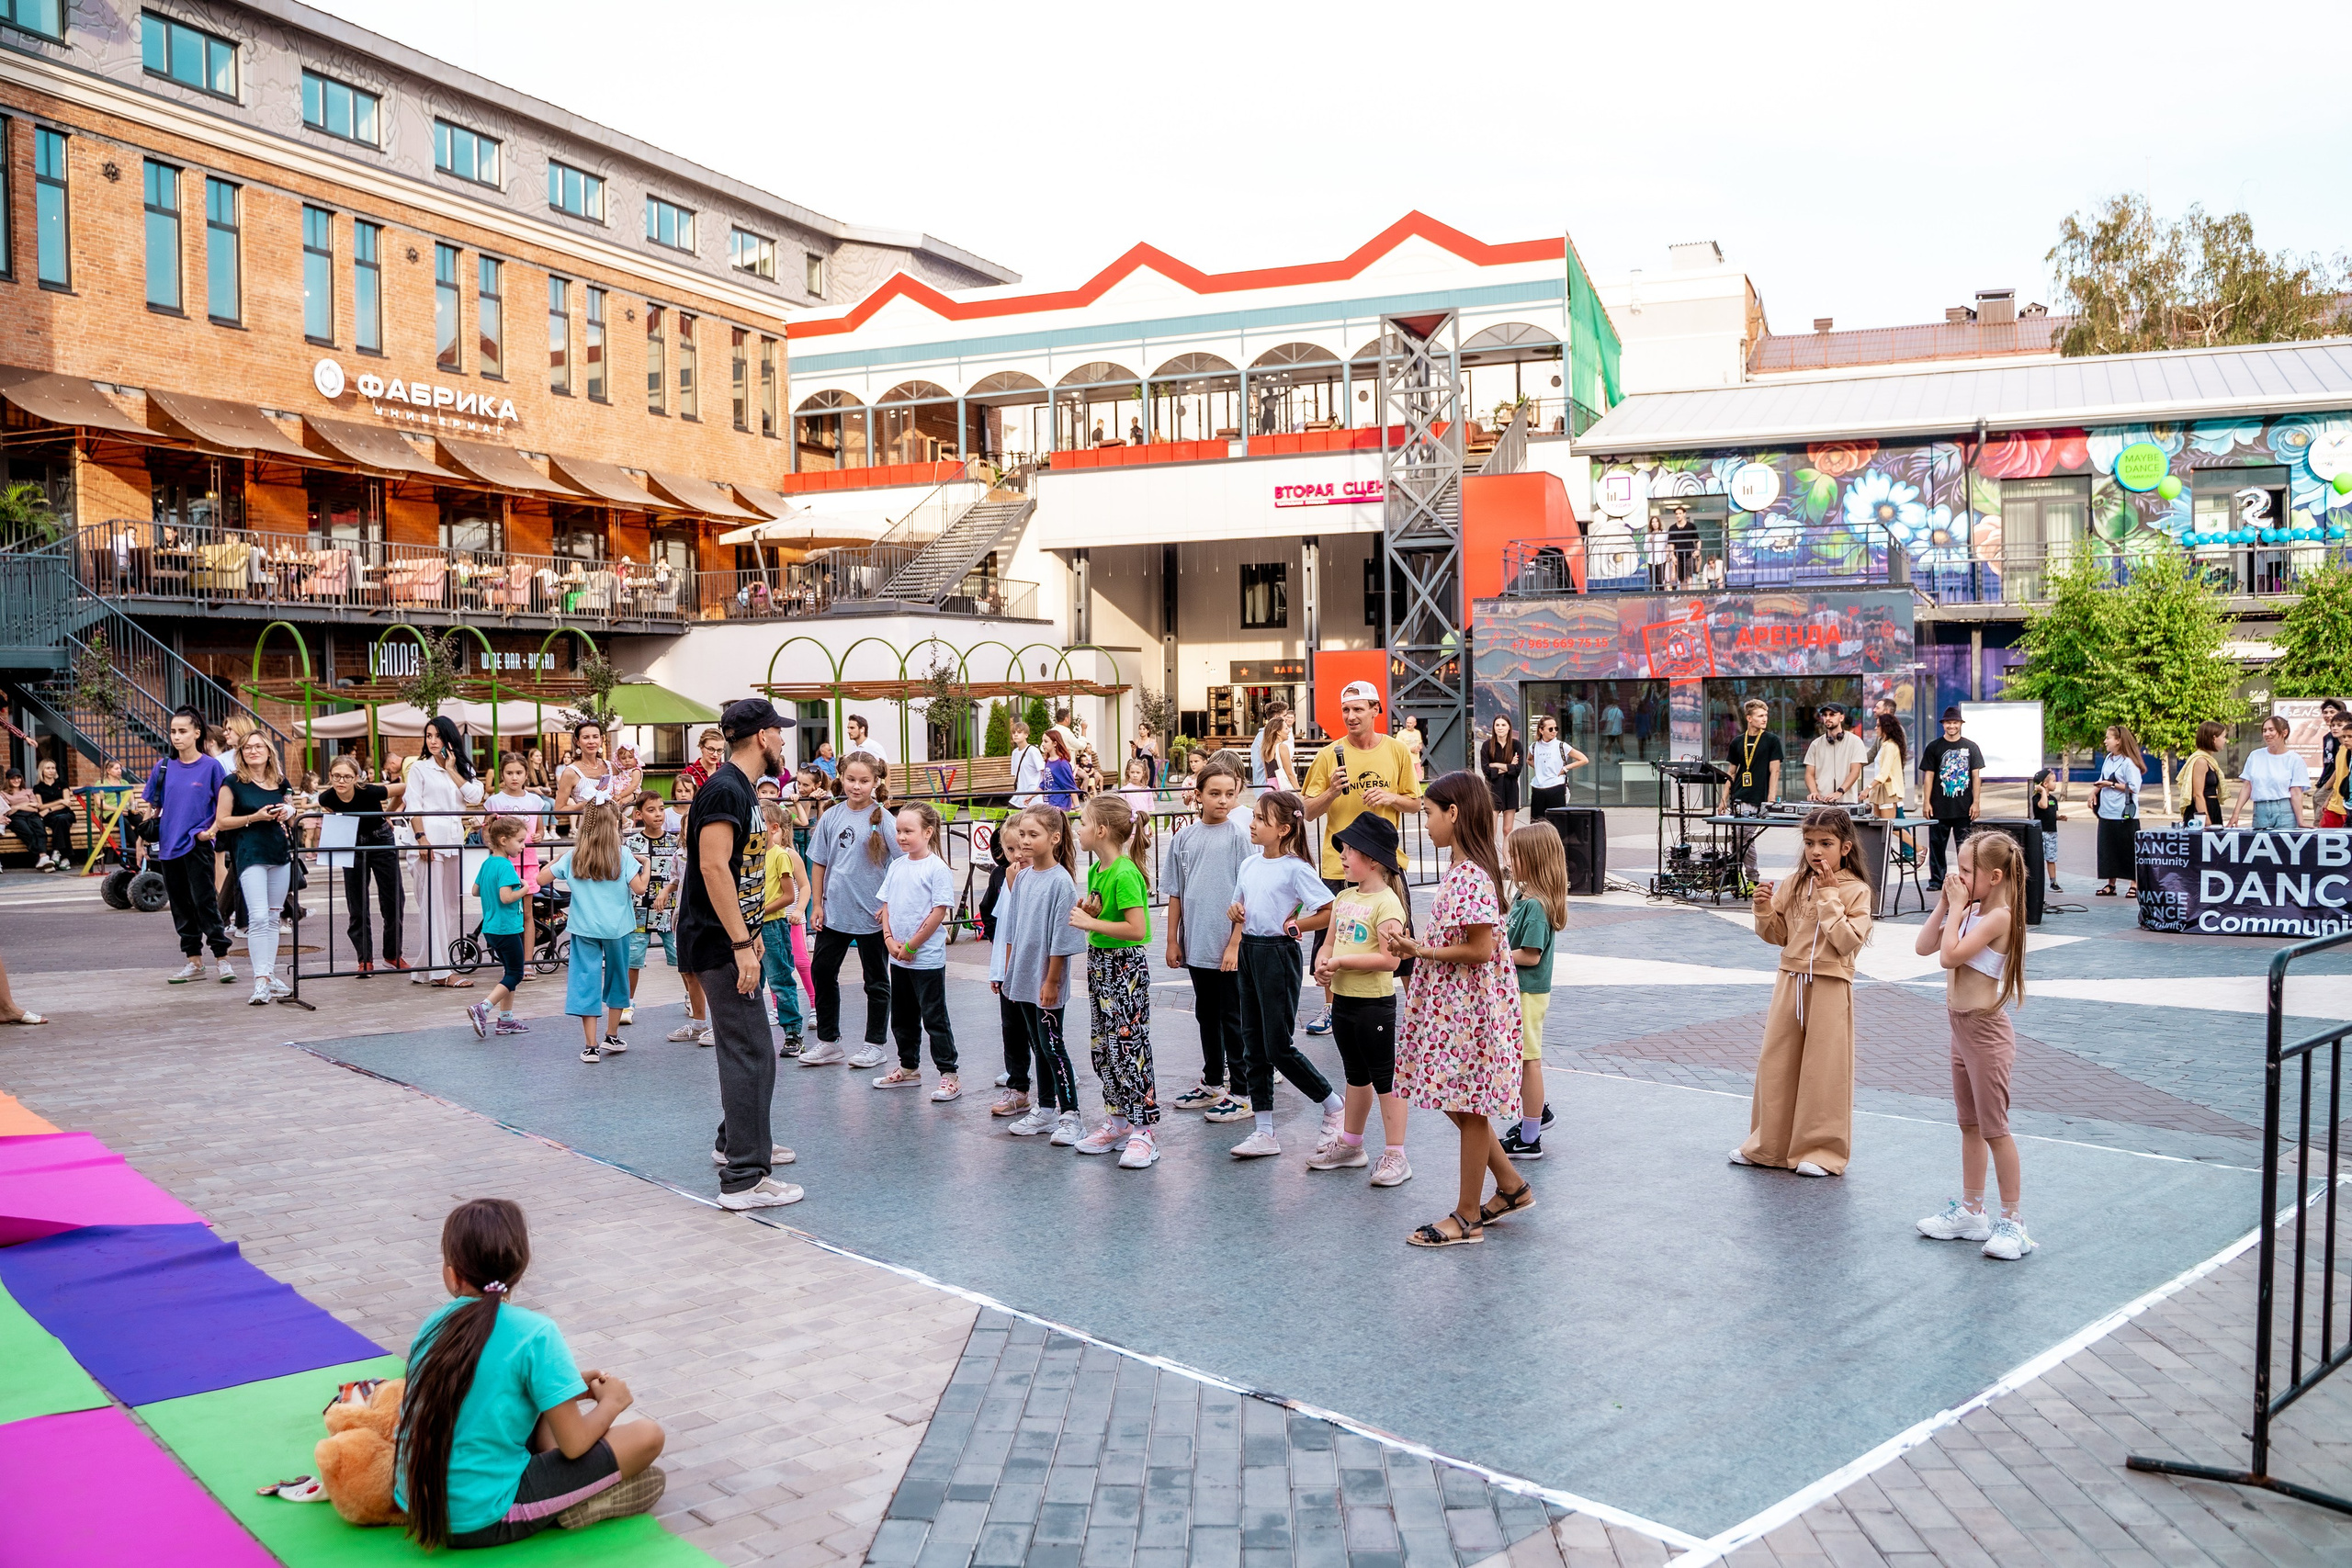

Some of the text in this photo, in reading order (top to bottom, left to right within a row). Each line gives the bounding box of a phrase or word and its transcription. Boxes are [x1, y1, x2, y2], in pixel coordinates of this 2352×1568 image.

[357, 374, 518, 422] ФАБРИКА
[374, 406, 504, 434] УНИВЕРМАГ
[2125, 453, 2159, 462] MAYBE
[2125, 464, 2159, 473] DANCE
[1274, 483, 1334, 499] ВТОРАЯ
[1511, 637, 1609, 649] +7 965 669 75 15
[1736, 625, 1843, 649] АРЕНДА
[504, 652, 522, 670] BAR
[1273, 665, 1293, 674] BAR
[2137, 890, 2188, 905] MAYBE
